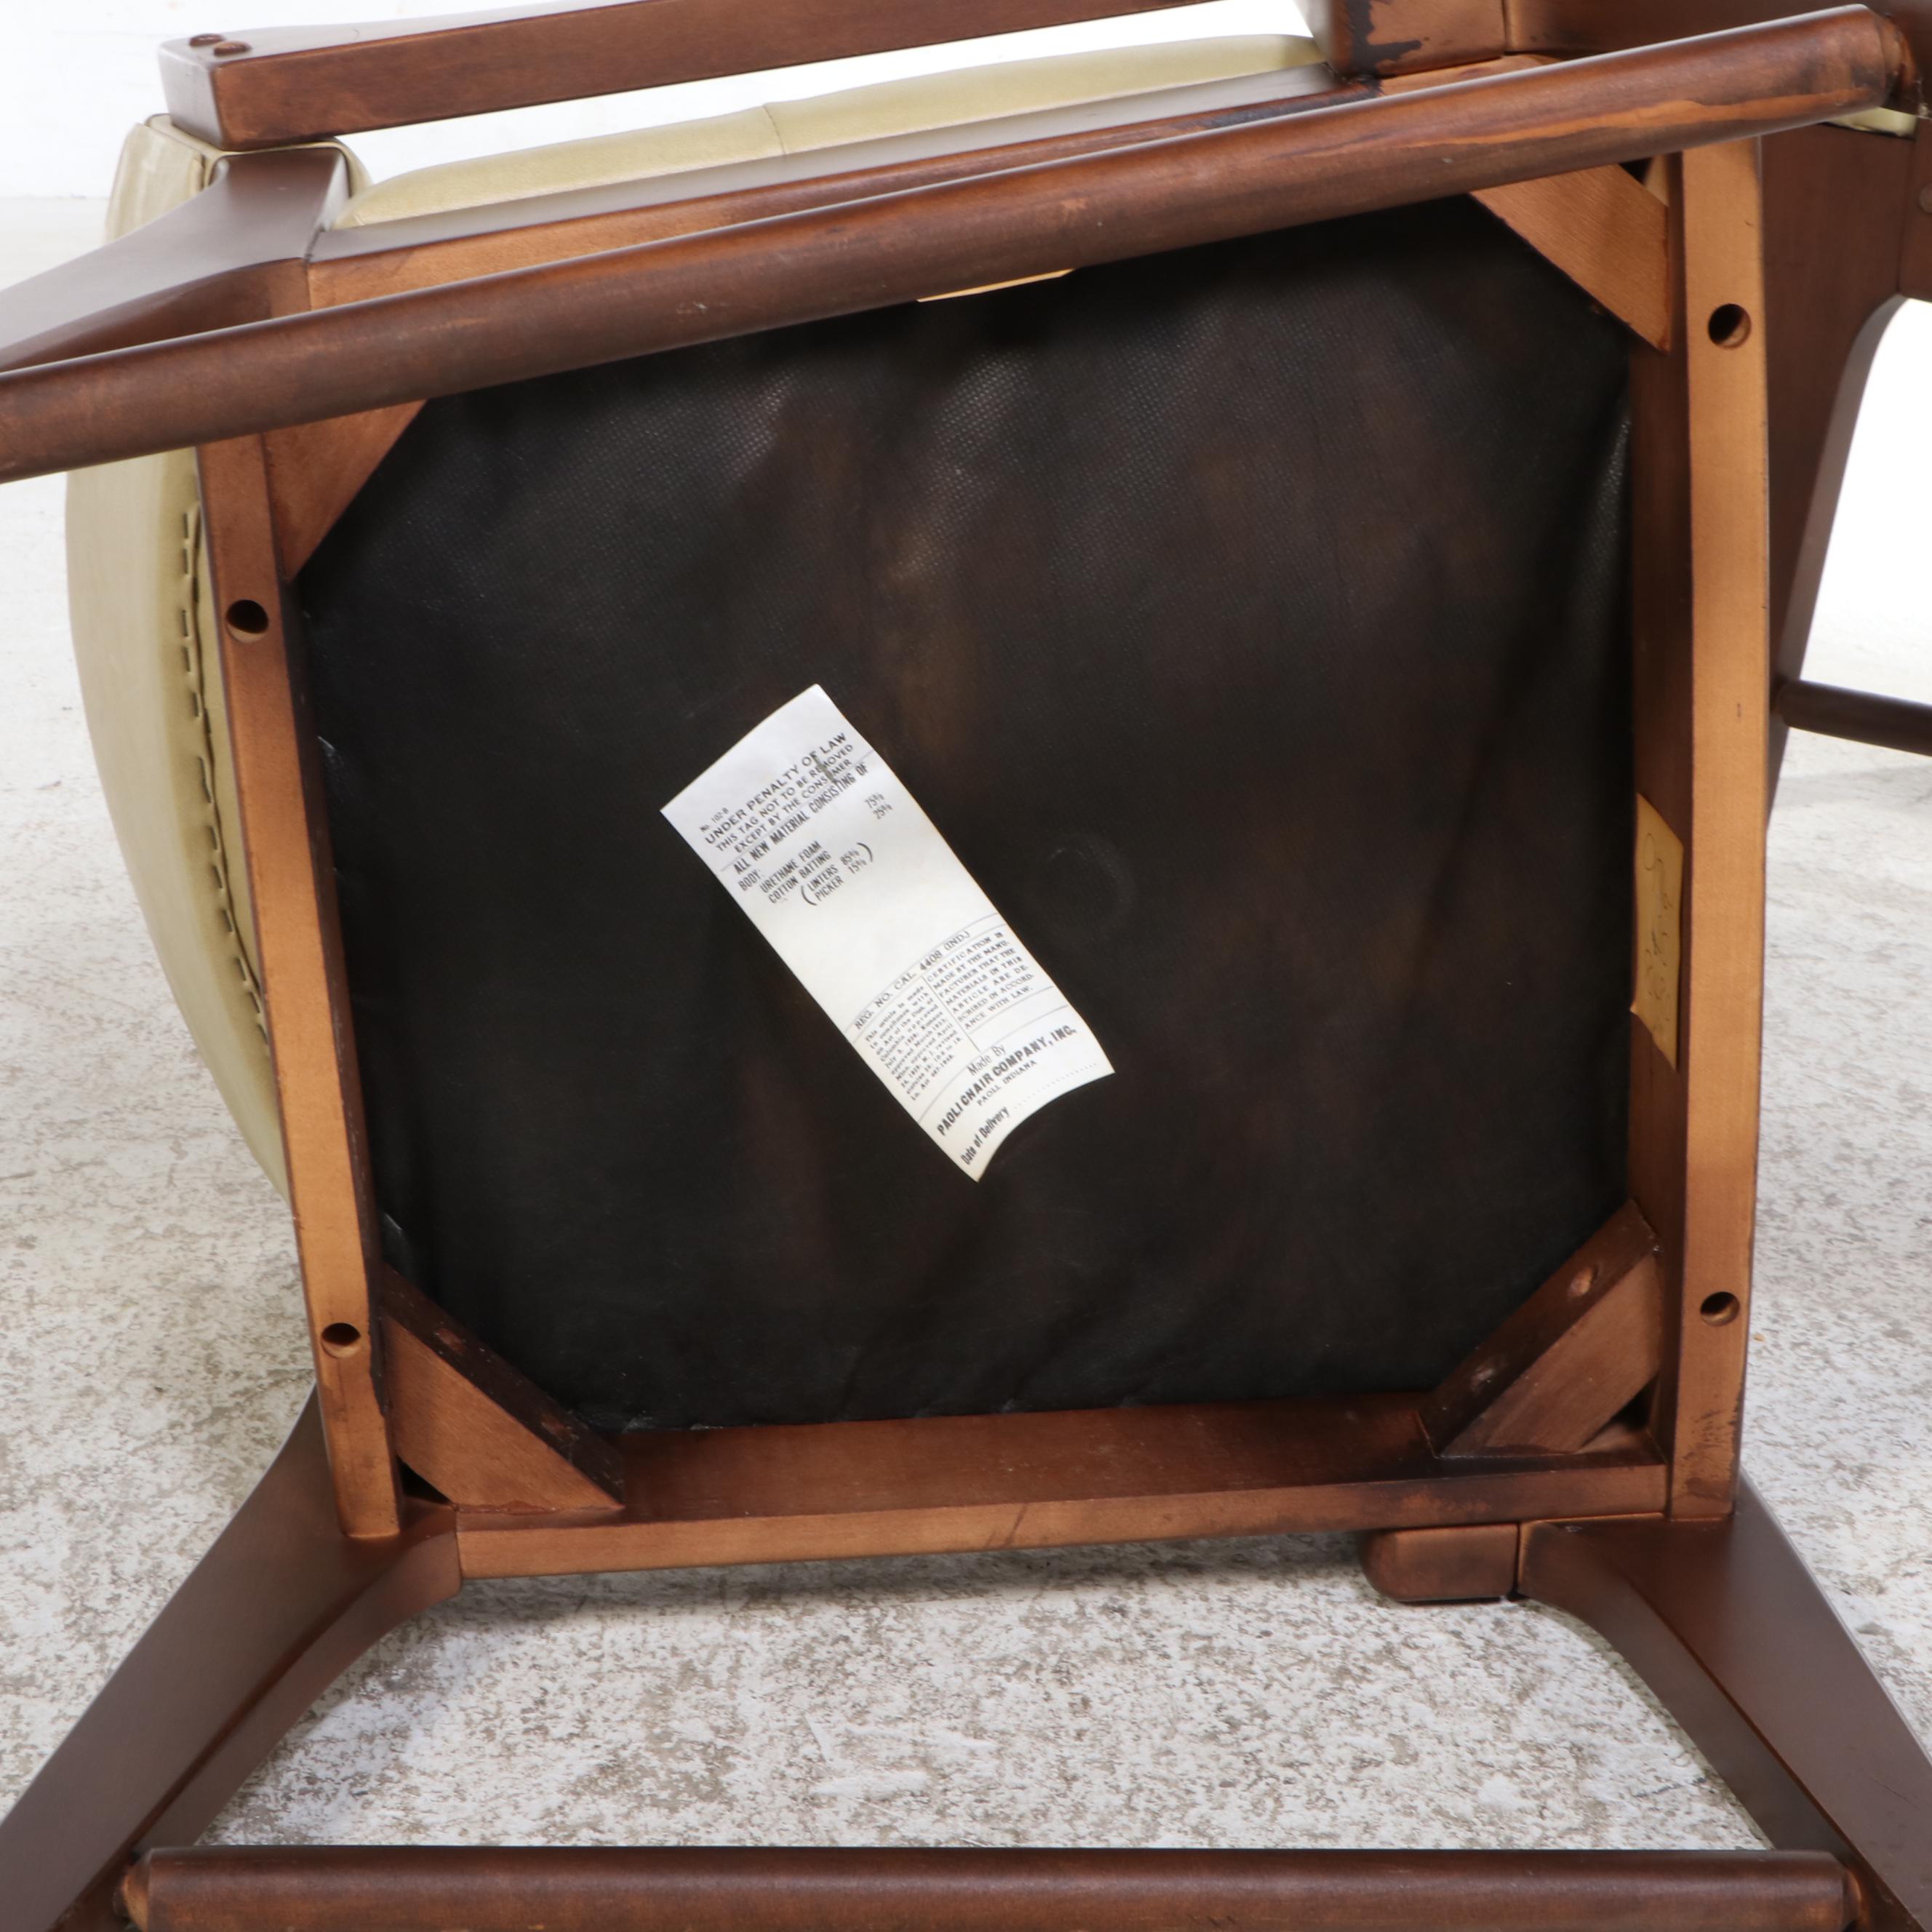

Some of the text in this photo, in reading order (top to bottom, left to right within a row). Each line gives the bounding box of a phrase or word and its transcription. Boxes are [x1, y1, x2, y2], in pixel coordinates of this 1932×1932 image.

[704, 733, 847, 845] UNDER PENALTY OF LAW
[715, 744, 853, 852] THIS TAG NOT TO BE REMOVED
[733, 759, 853, 854] EXCEPT BY THE CONSUMER
[733, 762, 869, 875] ALL NEW MATERIAL CONSISTING OF
[759, 793, 885, 893] URETHANE FOAM 75%
[767, 804, 893, 904] COTTON BATTING 25%
[813, 858, 868, 902] PICKER 15%
[919, 949, 943, 971] 4408
[927, 936, 992, 985] CERTIFICATION
[933, 970, 957, 990] MADE
[955, 963, 967, 973] BY
[966, 952, 983, 965] THE
[937, 947, 1016, 1002] FACTURER THAT THE
[945, 973, 989, 1006] MATERIALS
[989, 967, 999, 975] IN
[951, 985, 990, 1015] ARTICLE
[992, 972, 1012, 986] ARE
[957, 997, 989, 1026] SCRIBED
[988, 991, 999, 1000] IN
[964, 1011, 986, 1030] ANCE
[987, 997, 1010, 1012] WITH
[936, 1025, 1077, 1136] PAOLI CHAIR COMPANY, INC.
[965, 1041, 1007, 1077] Made By
[1002, 1059, 1037, 1085] INDIANA
[959, 1106, 1010, 1165] Date of Delivery
